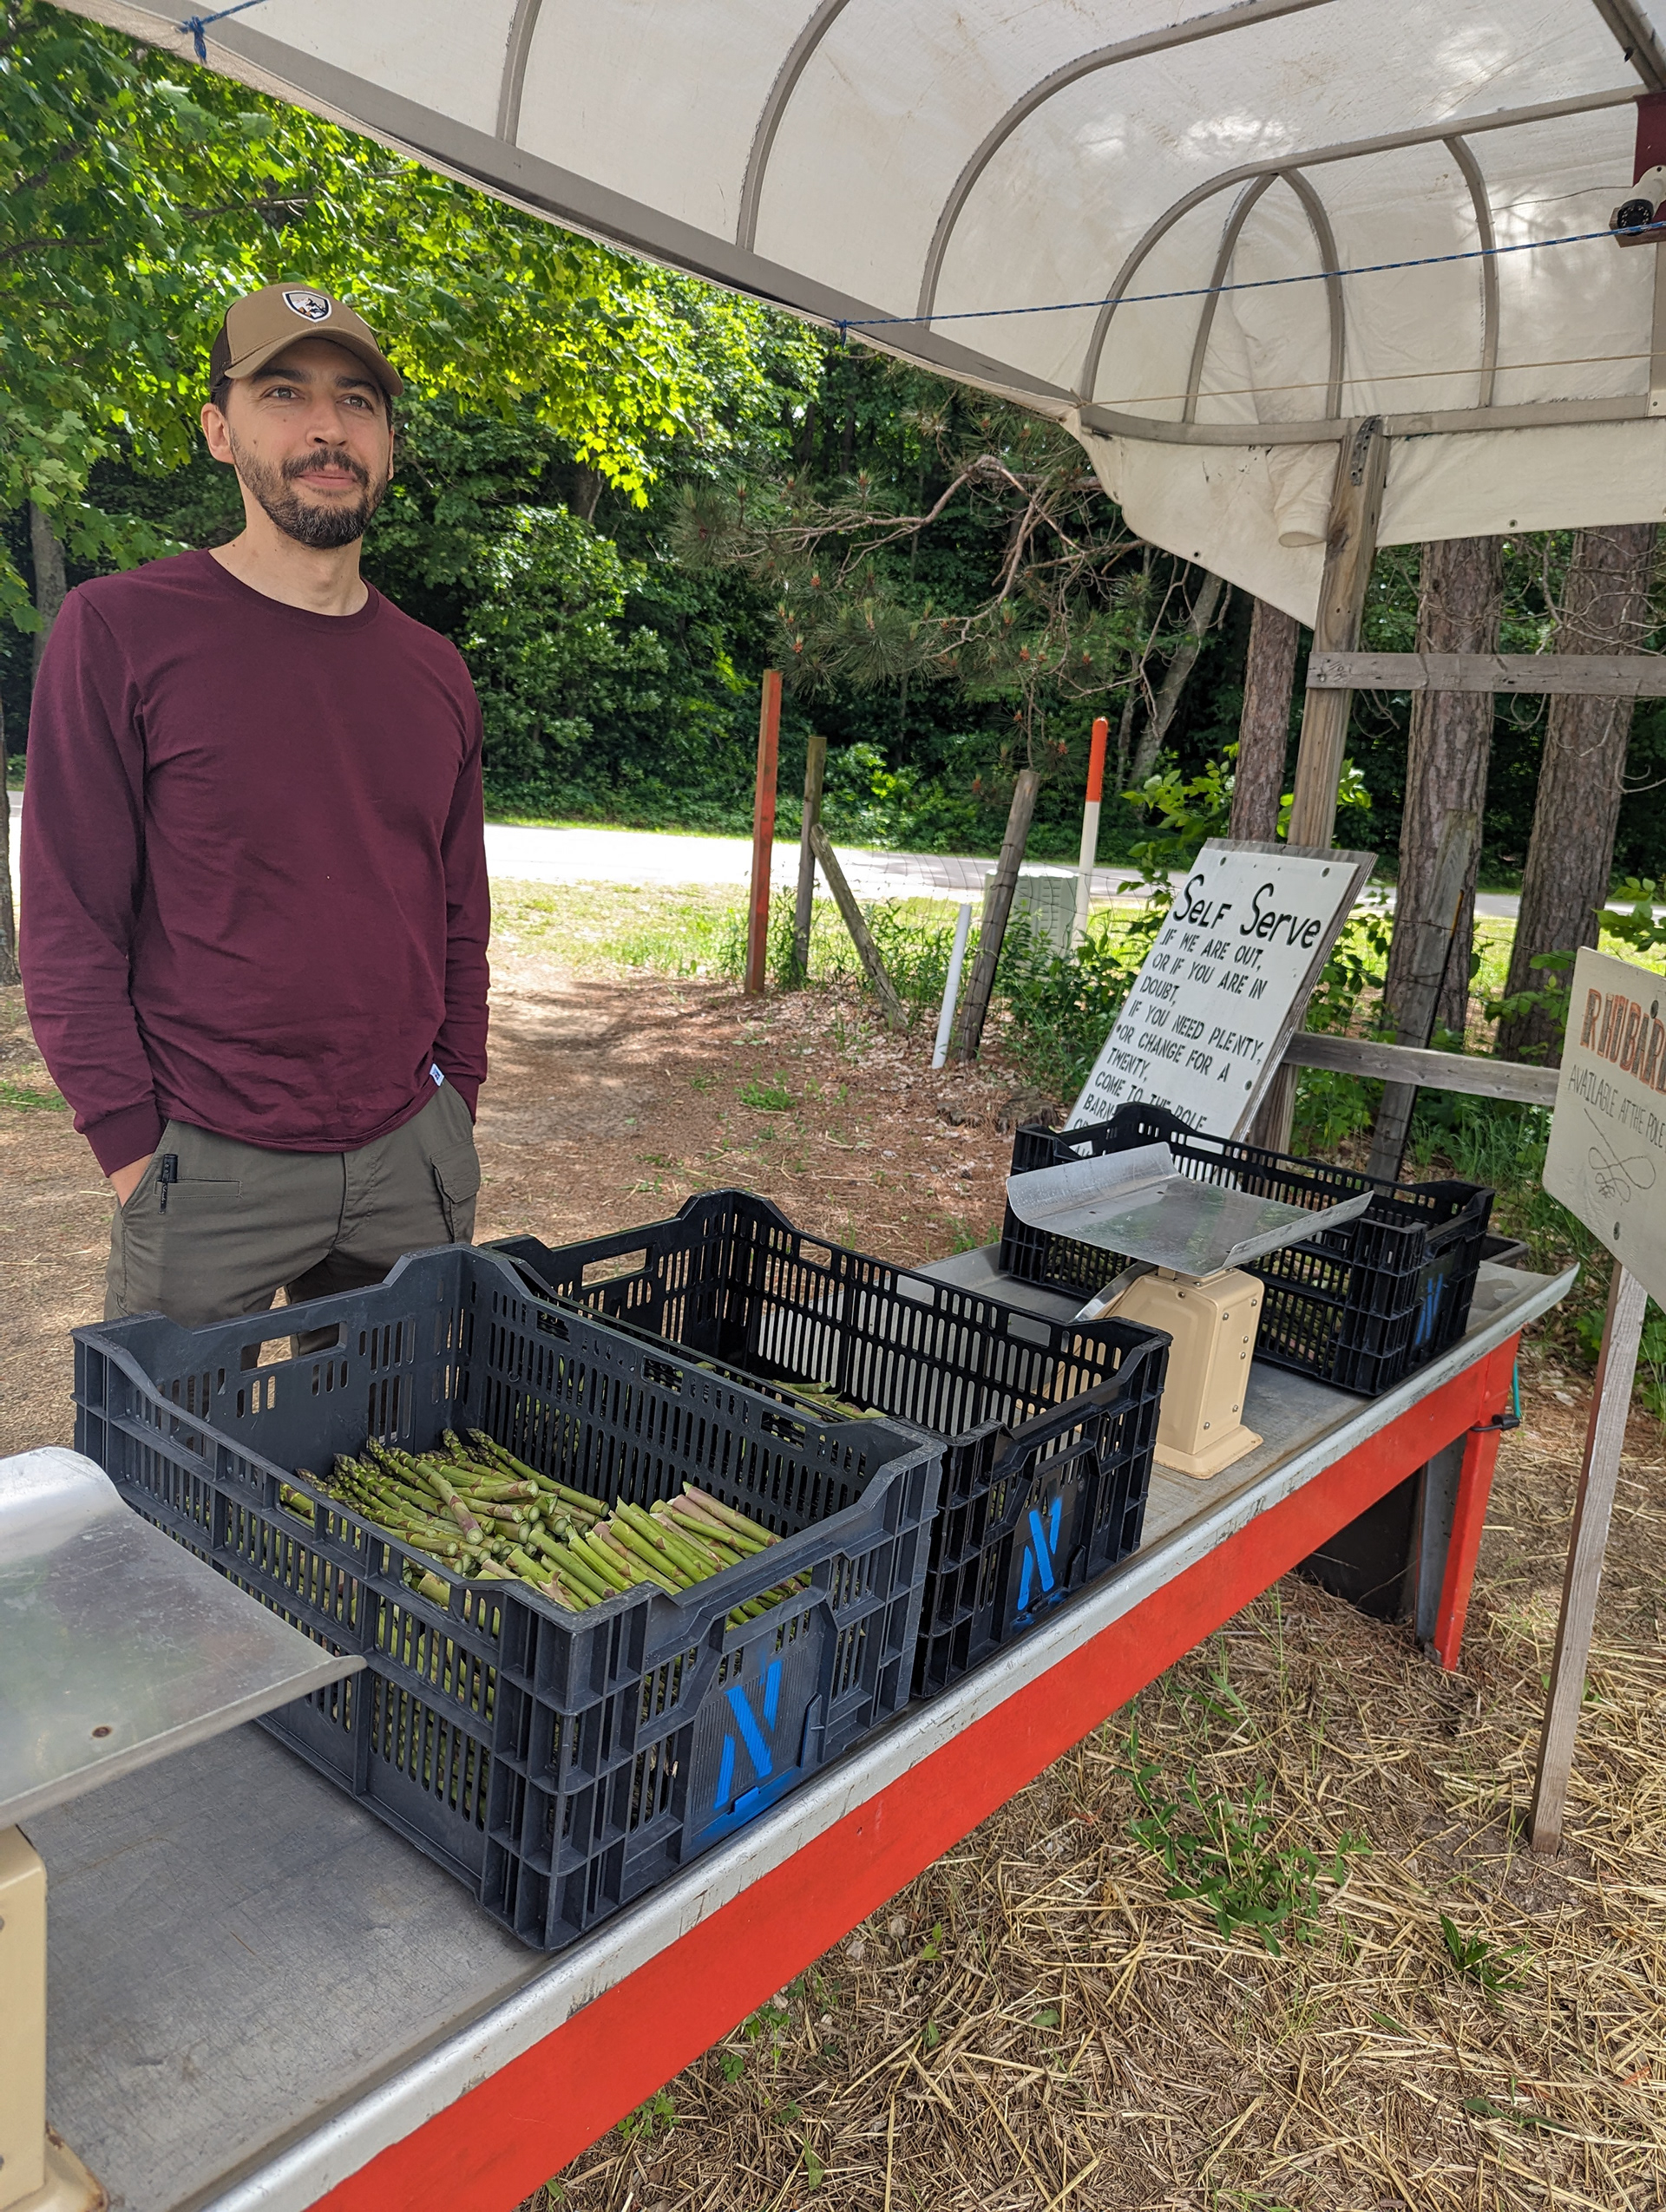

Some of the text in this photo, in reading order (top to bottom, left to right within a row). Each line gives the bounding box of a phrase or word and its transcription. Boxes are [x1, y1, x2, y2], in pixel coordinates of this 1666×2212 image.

[1240, 882, 1322, 949] Serve
[1159, 928, 1263, 972] IF WE ARE OUT,
[1139, 975, 1180, 1007] DOUBT,
[1151, 952, 1268, 999] OR IF YOU ARE IN
[1118, 1024, 1230, 1083] OR CHANGE FOR A
[1128, 999, 1264, 1065] IF YOU NEED PLENTY,
[1094, 1071, 1126, 1097] COME
[1126, 1084, 1144, 1103] TO
[1106, 1047, 1151, 1083] TWENTY,
[1568, 1064, 1618, 1117] AVAILABLE
[1645, 1112, 1666, 1149] POLE
